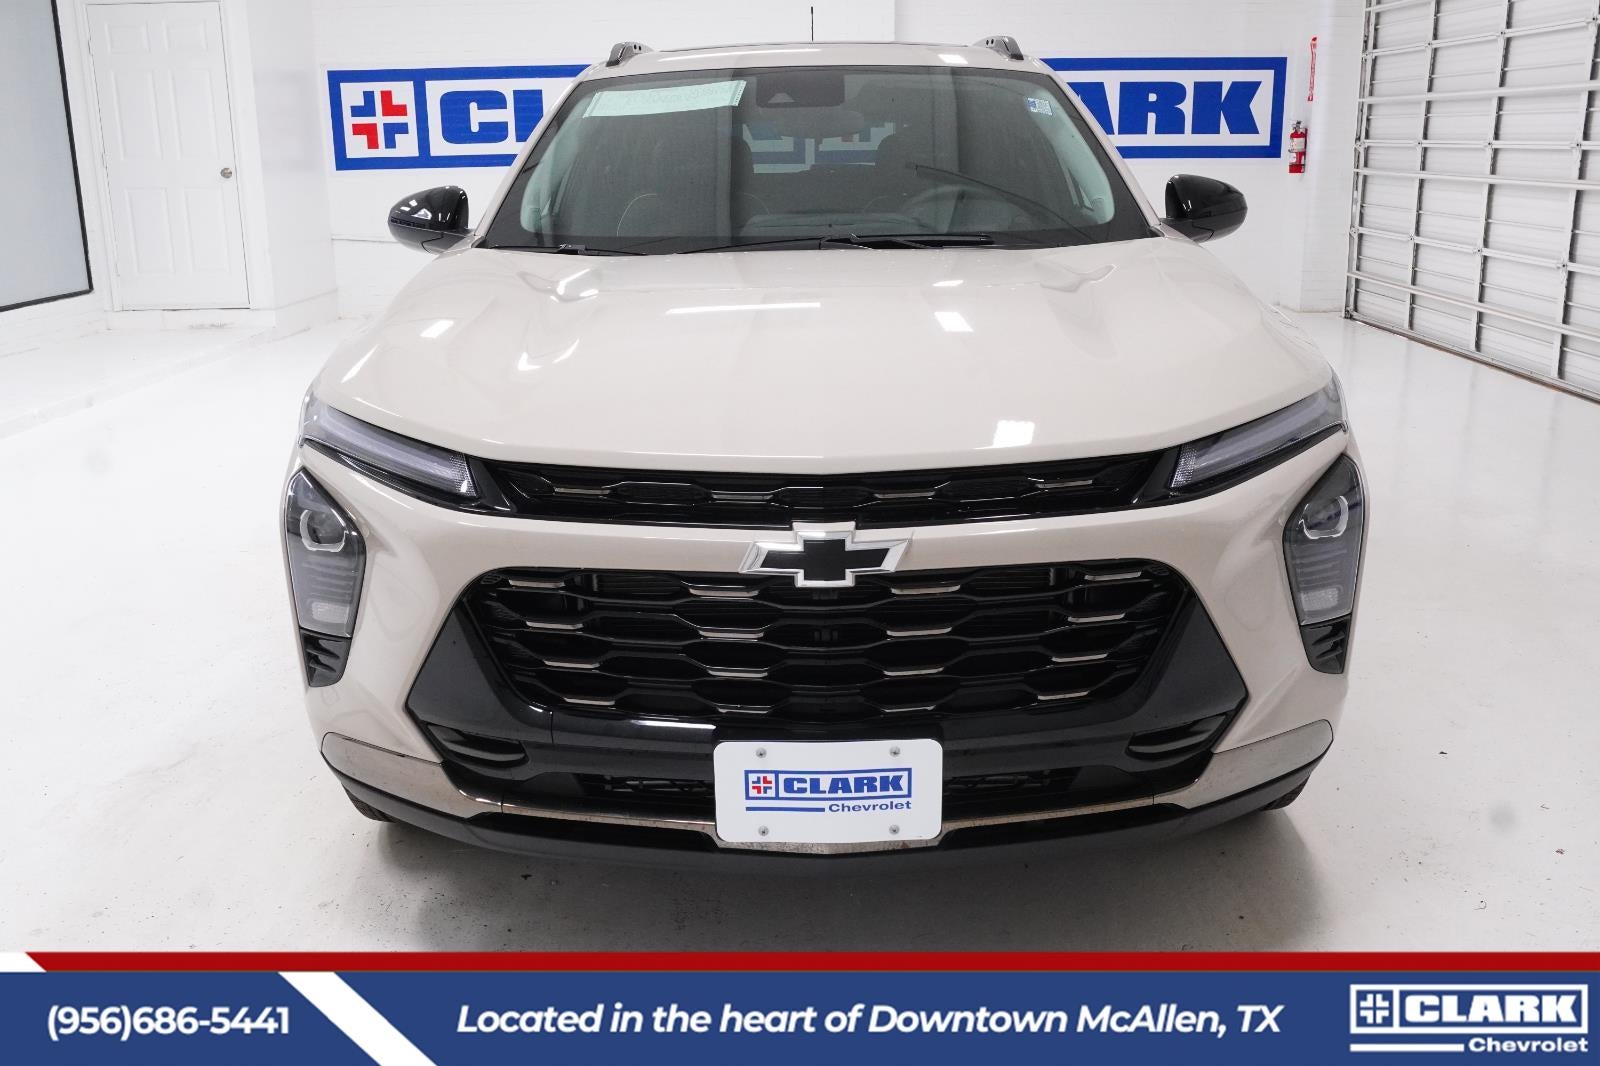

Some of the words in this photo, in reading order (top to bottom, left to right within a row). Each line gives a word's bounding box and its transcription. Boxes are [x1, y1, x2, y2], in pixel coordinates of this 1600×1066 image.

[1066, 80, 1262, 136] ARK
[783, 775, 904, 795] CLARK
[828, 800, 912, 813] Chevrolet
